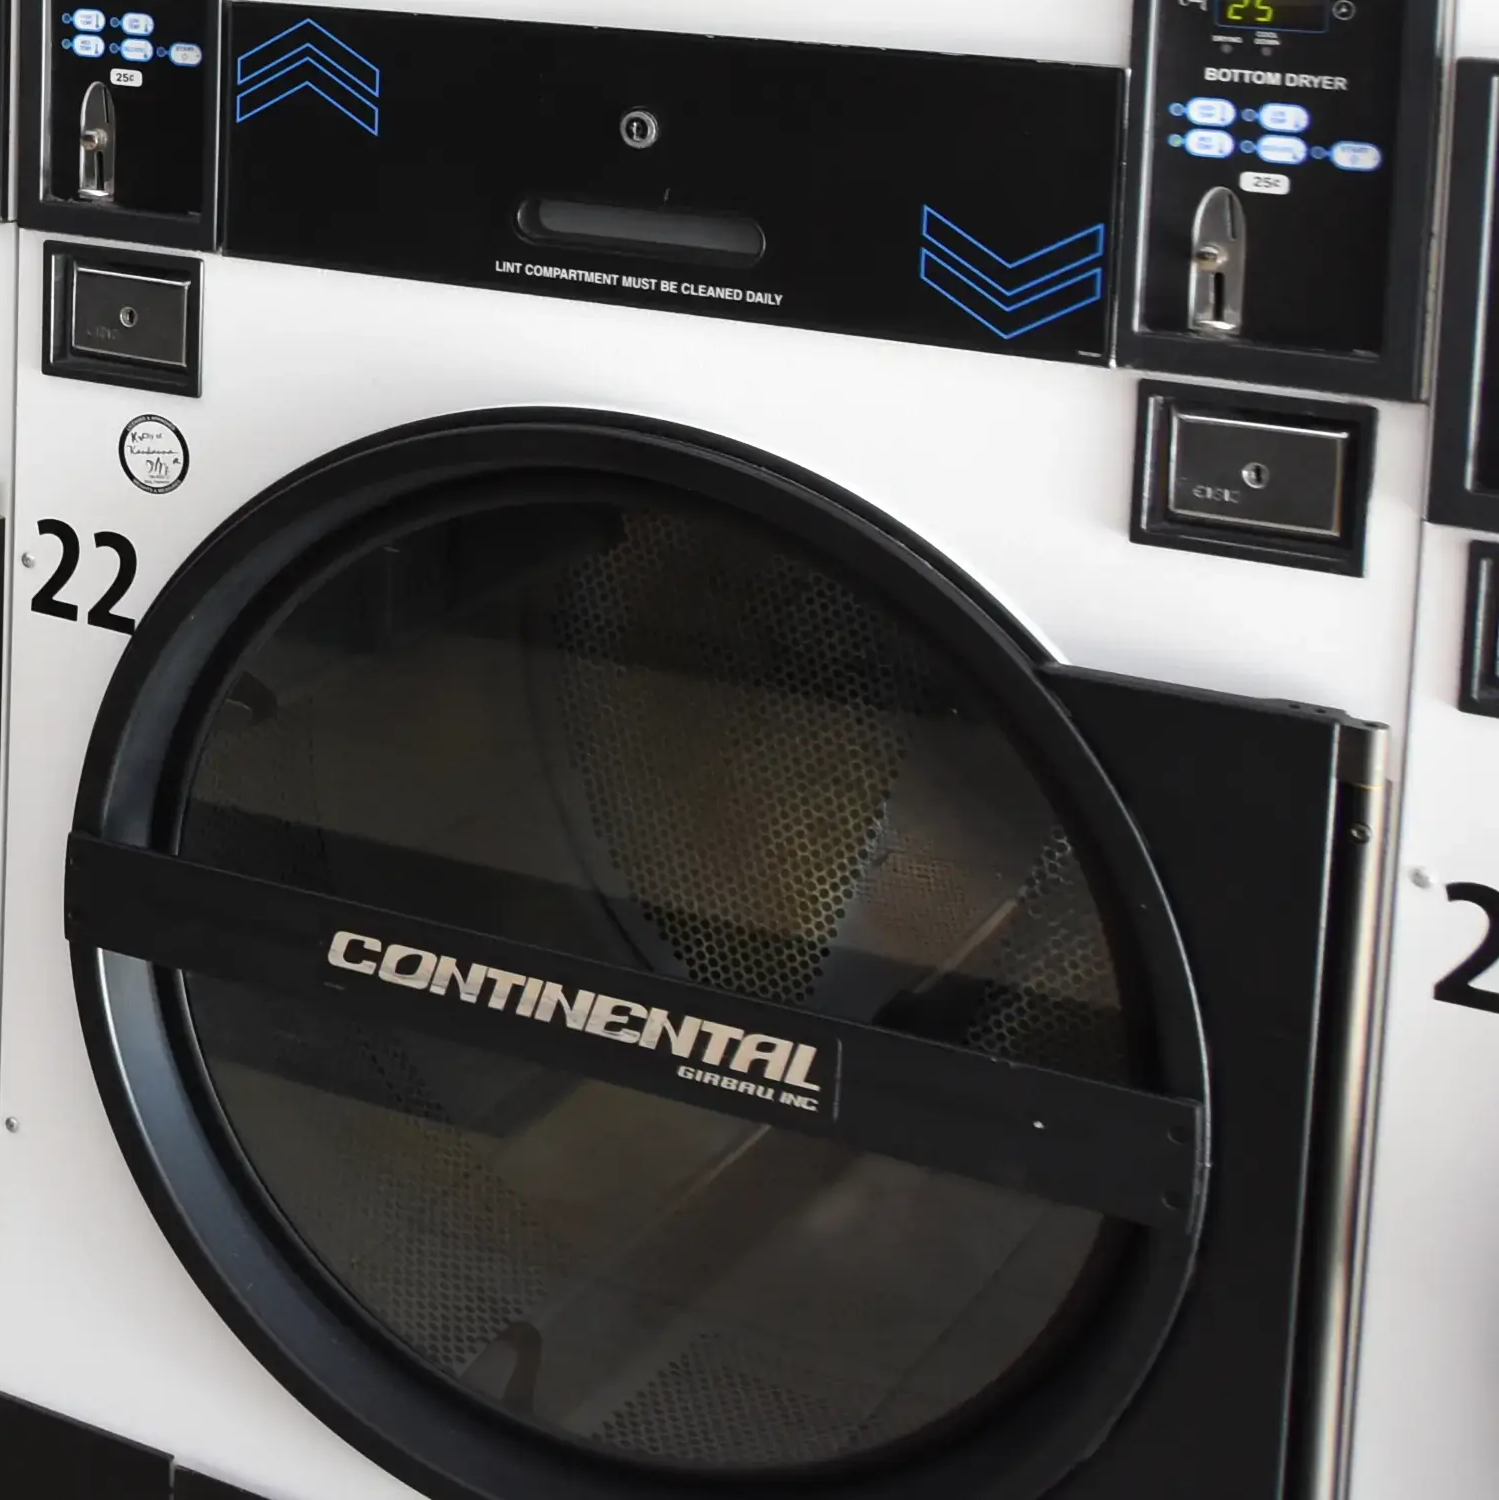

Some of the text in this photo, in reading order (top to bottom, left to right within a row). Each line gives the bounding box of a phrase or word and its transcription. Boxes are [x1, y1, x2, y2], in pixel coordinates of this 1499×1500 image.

[1204, 67, 1348, 91] BOTTOM DRYER
[495, 260, 783, 307] LINT COMPARTMENT MUST BE CLEANED DAILY
[31, 518, 138, 636] 22
[326, 930, 822, 1092] CONTINENTAL
